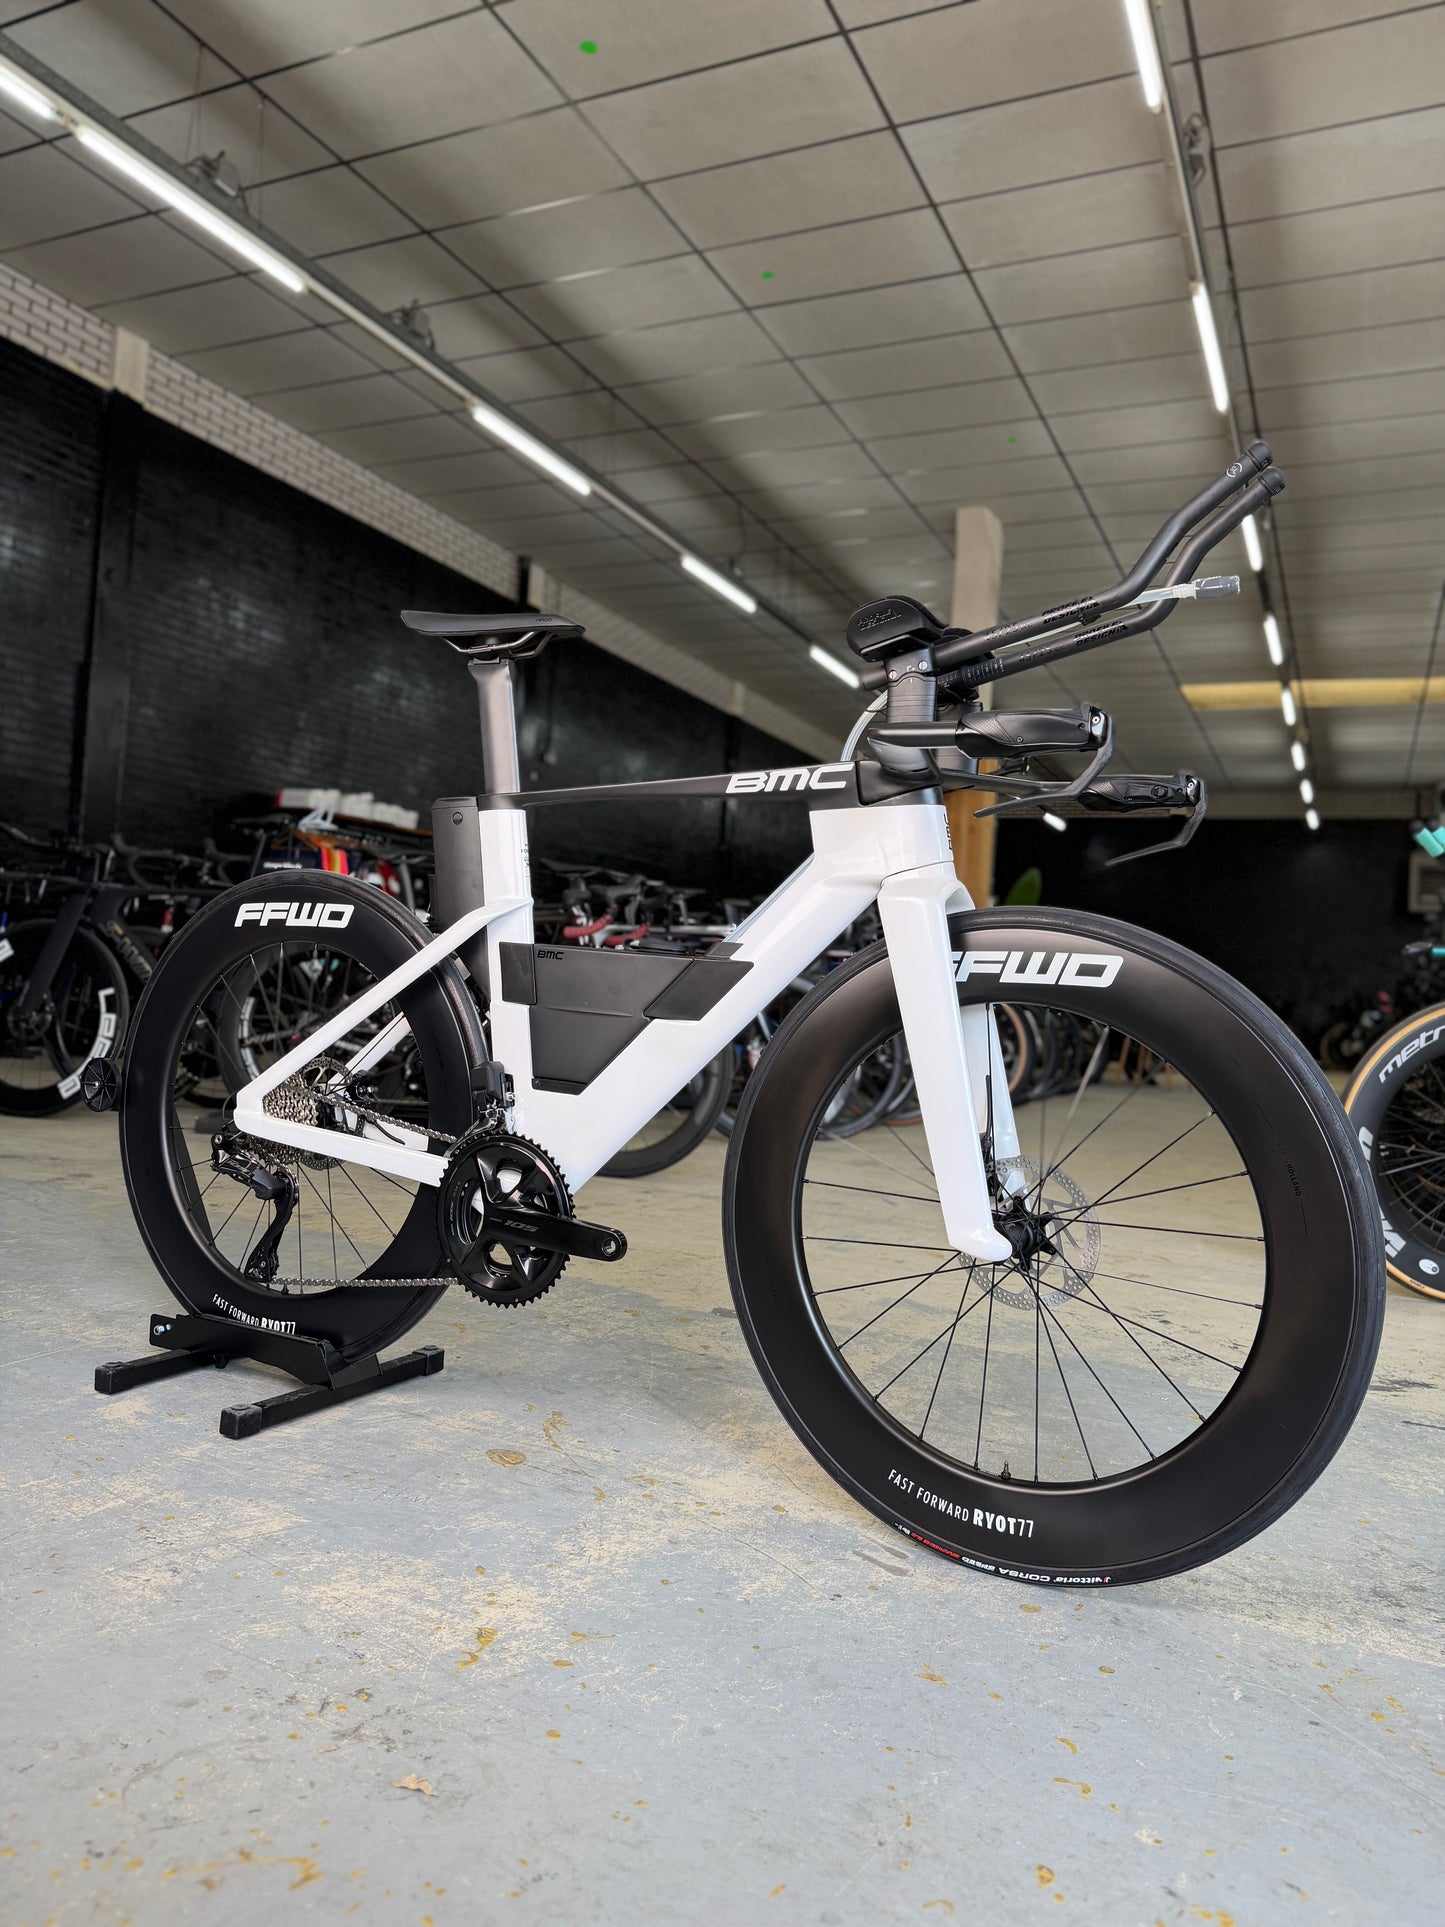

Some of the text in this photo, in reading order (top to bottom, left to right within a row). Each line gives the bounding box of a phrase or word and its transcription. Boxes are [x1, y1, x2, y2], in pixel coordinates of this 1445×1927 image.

[725, 763, 854, 793] BMC
[537, 950, 564, 960] BMC
[1286, 1163, 1302, 1197] HOLLAND
[504, 1219, 539, 1233] 105
[212, 1293, 229, 1311] FAST
[228, 1305, 260, 1327] FORWARD
[888, 1469, 1034, 1538] FAST FORWARD RYOT77
[998, 1567, 1051, 1582] CORSA
[1055, 1576, 1102, 1584] vittoria
